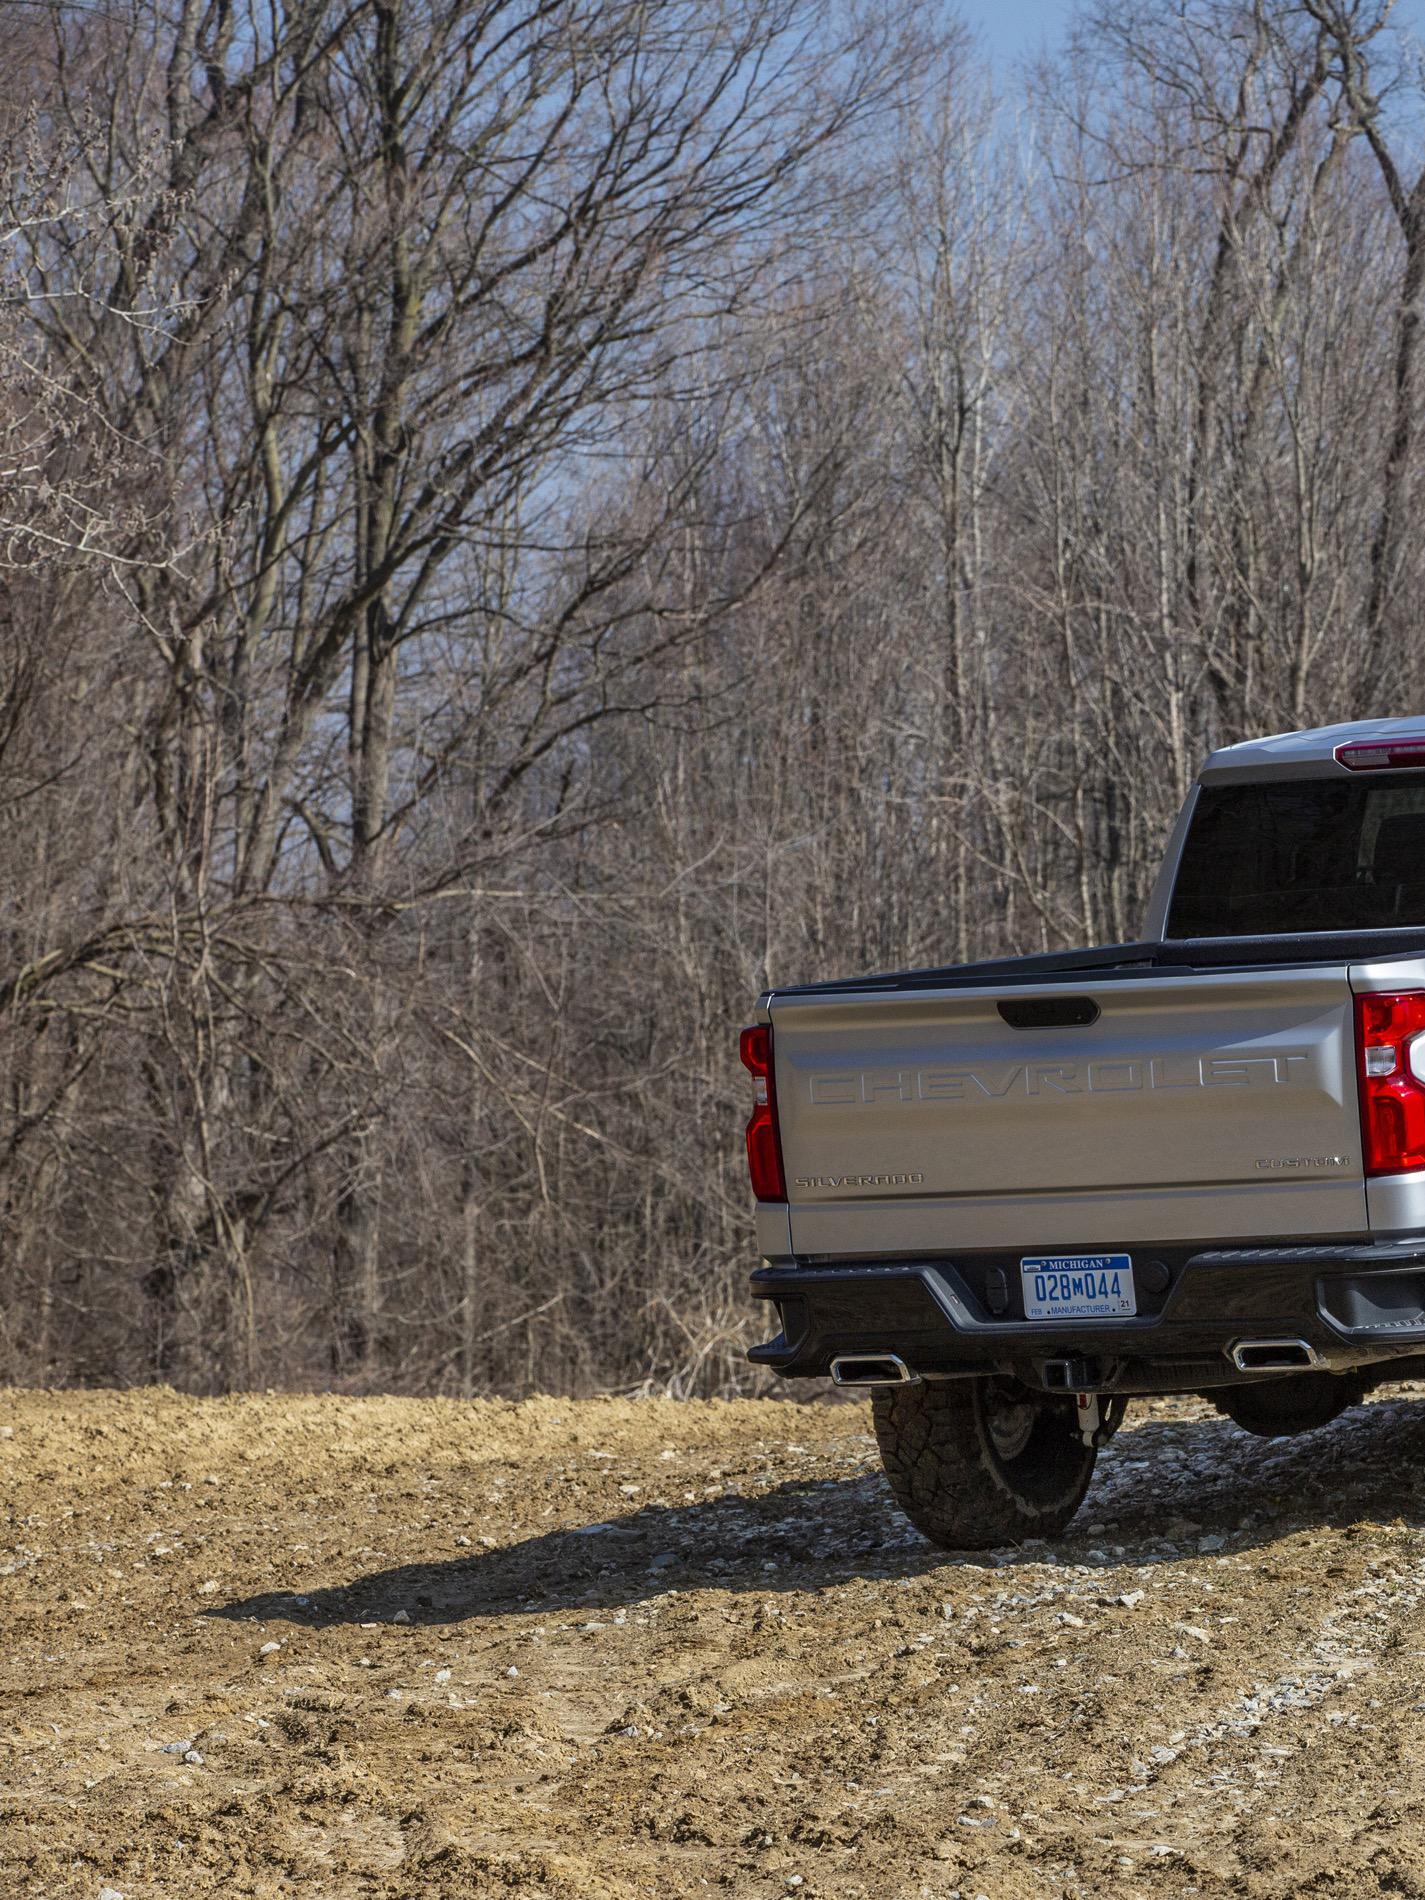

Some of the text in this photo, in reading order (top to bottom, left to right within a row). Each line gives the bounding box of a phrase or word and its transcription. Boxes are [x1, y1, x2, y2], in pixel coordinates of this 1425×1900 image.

[810, 1053, 1308, 1105] CHEVROLET
[1255, 1156, 1350, 1169] CUSTOM
[795, 1173, 924, 1188] SILVERADO
[1049, 1259, 1104, 1270] MICHIGAN
[1034, 1271, 1121, 1302] 028M044
[1051, 1304, 1111, 1315] MANUFACTURER
[1120, 1300, 1130, 1308] 21
[1031, 1308, 1043, 1316] FEB
